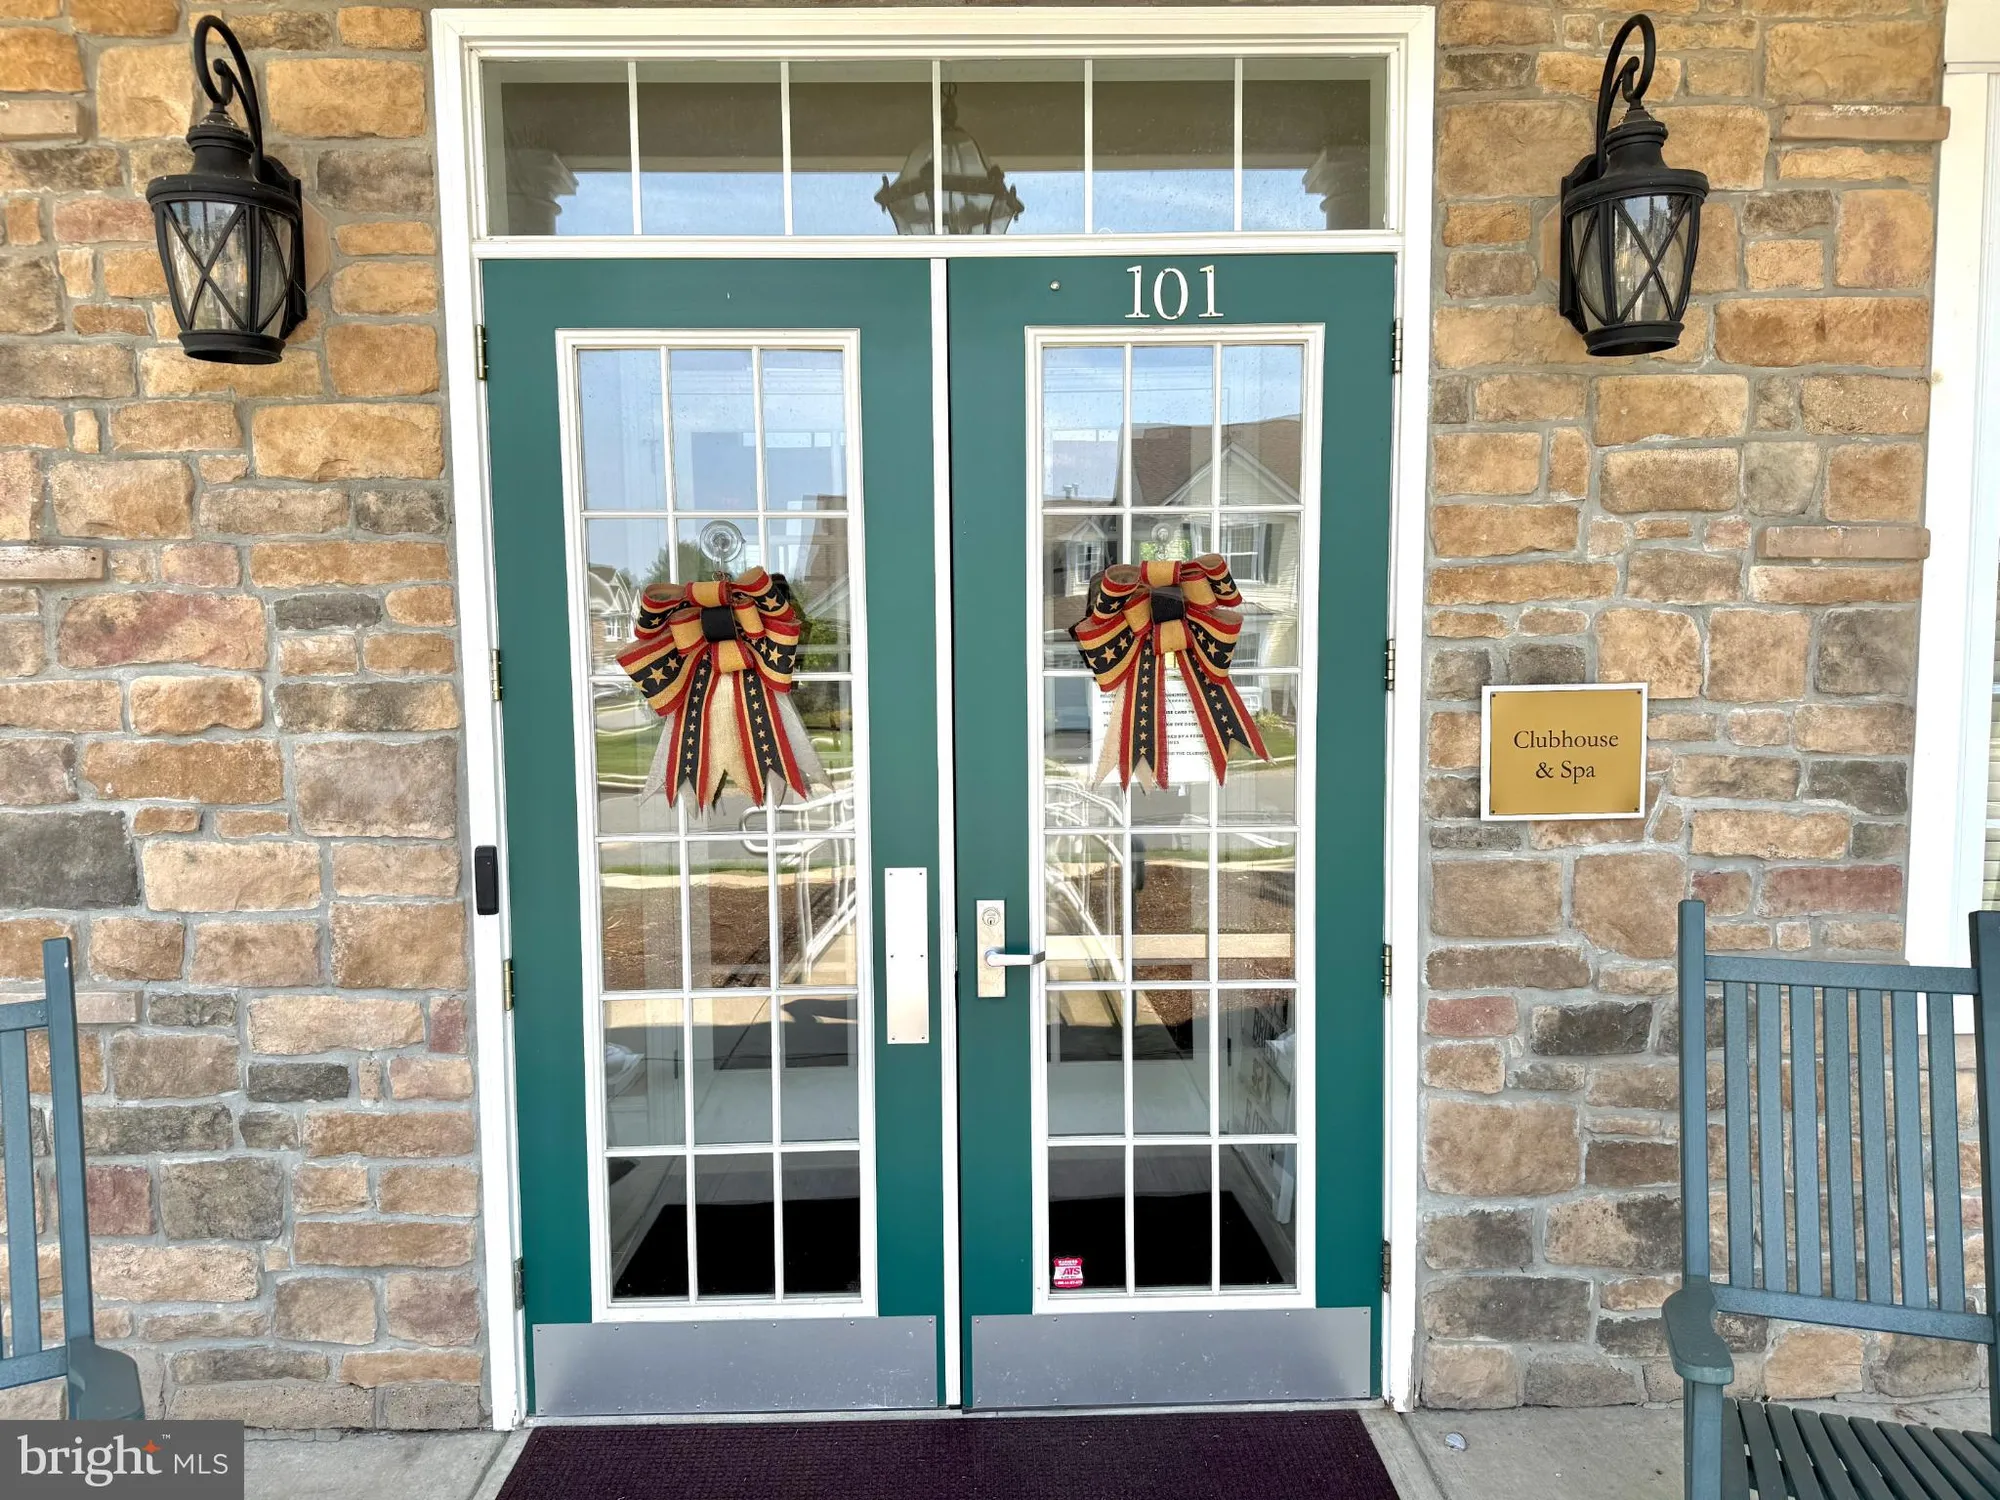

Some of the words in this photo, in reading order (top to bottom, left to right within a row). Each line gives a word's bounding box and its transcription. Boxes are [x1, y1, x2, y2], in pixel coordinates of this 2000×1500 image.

[1125, 264, 1224, 321] 101
[1513, 730, 1619, 749] Clubhouse
[1535, 761, 1554, 779] &
[1560, 760, 1596, 785] Spa
